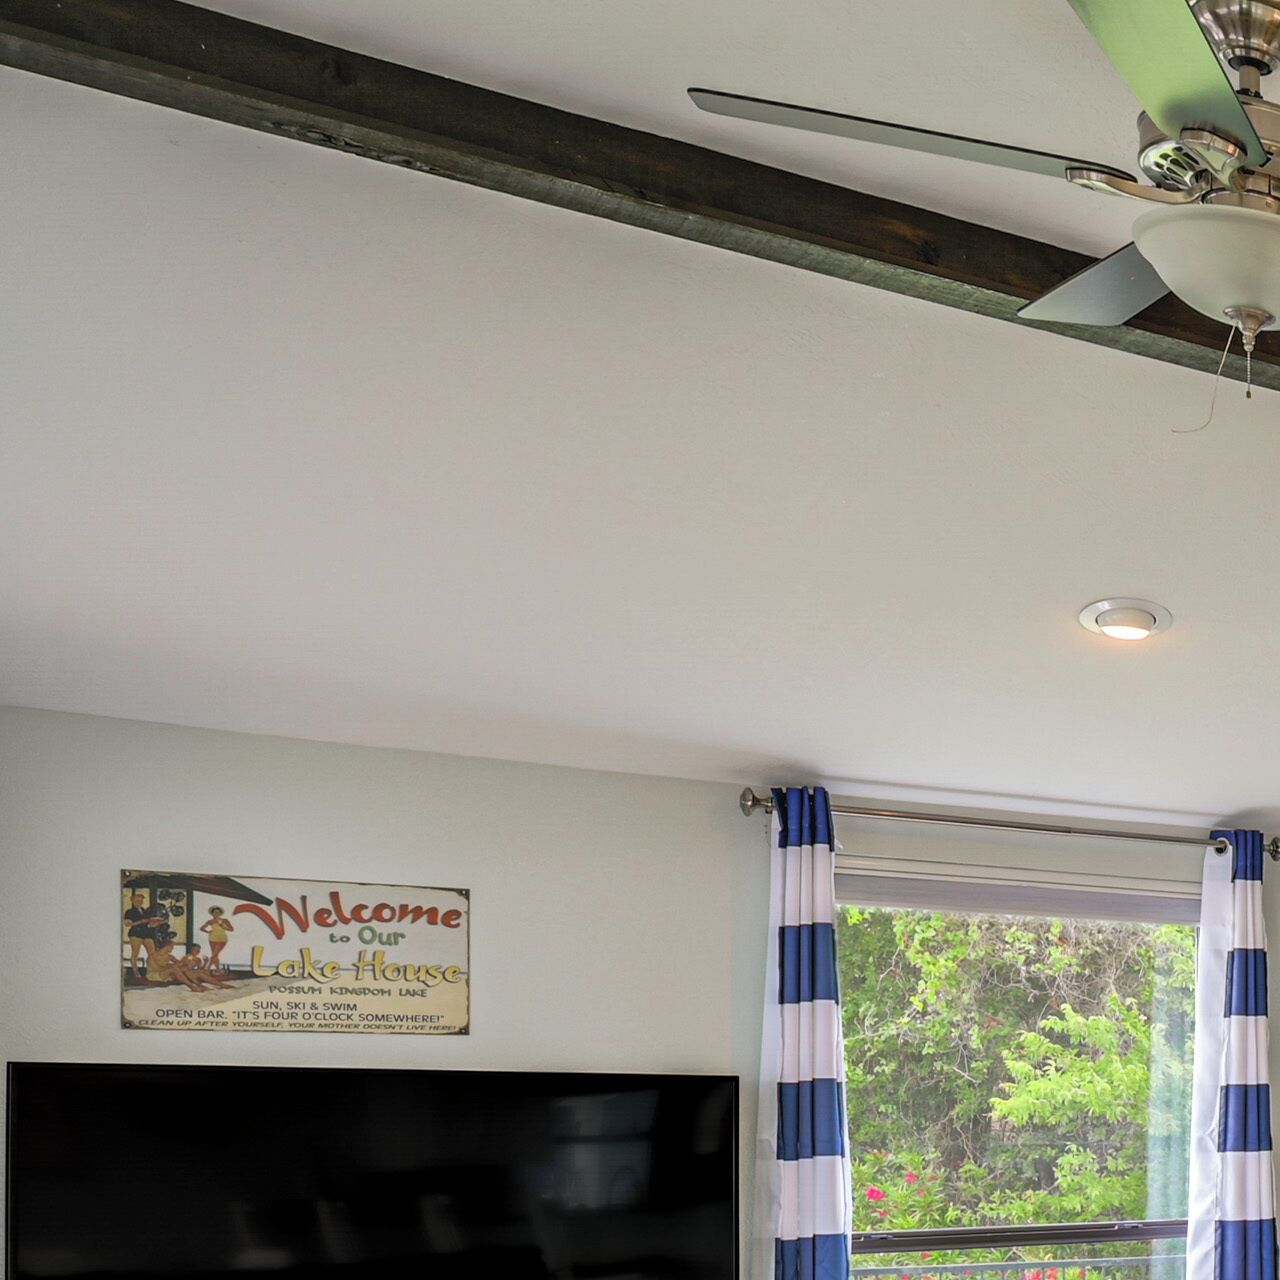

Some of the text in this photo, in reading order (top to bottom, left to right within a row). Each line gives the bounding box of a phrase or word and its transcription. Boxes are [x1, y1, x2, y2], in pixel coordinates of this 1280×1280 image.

[232, 891, 463, 940] Welcome
[330, 925, 406, 946] to Our
[251, 946, 462, 988] Lake House
[269, 985, 428, 998] POSSUM KINGDOM LAKE
[253, 1001, 357, 1012] SUN, SKI & SWIM
[155, 1009, 193, 1018] OPEN
[198, 1010, 228, 1020] BAR.
[265, 1011, 298, 1020] FOUR
[303, 1012, 354, 1021] O'CLOCK
[359, 1013, 445, 1023] SOMEWHERE!"
